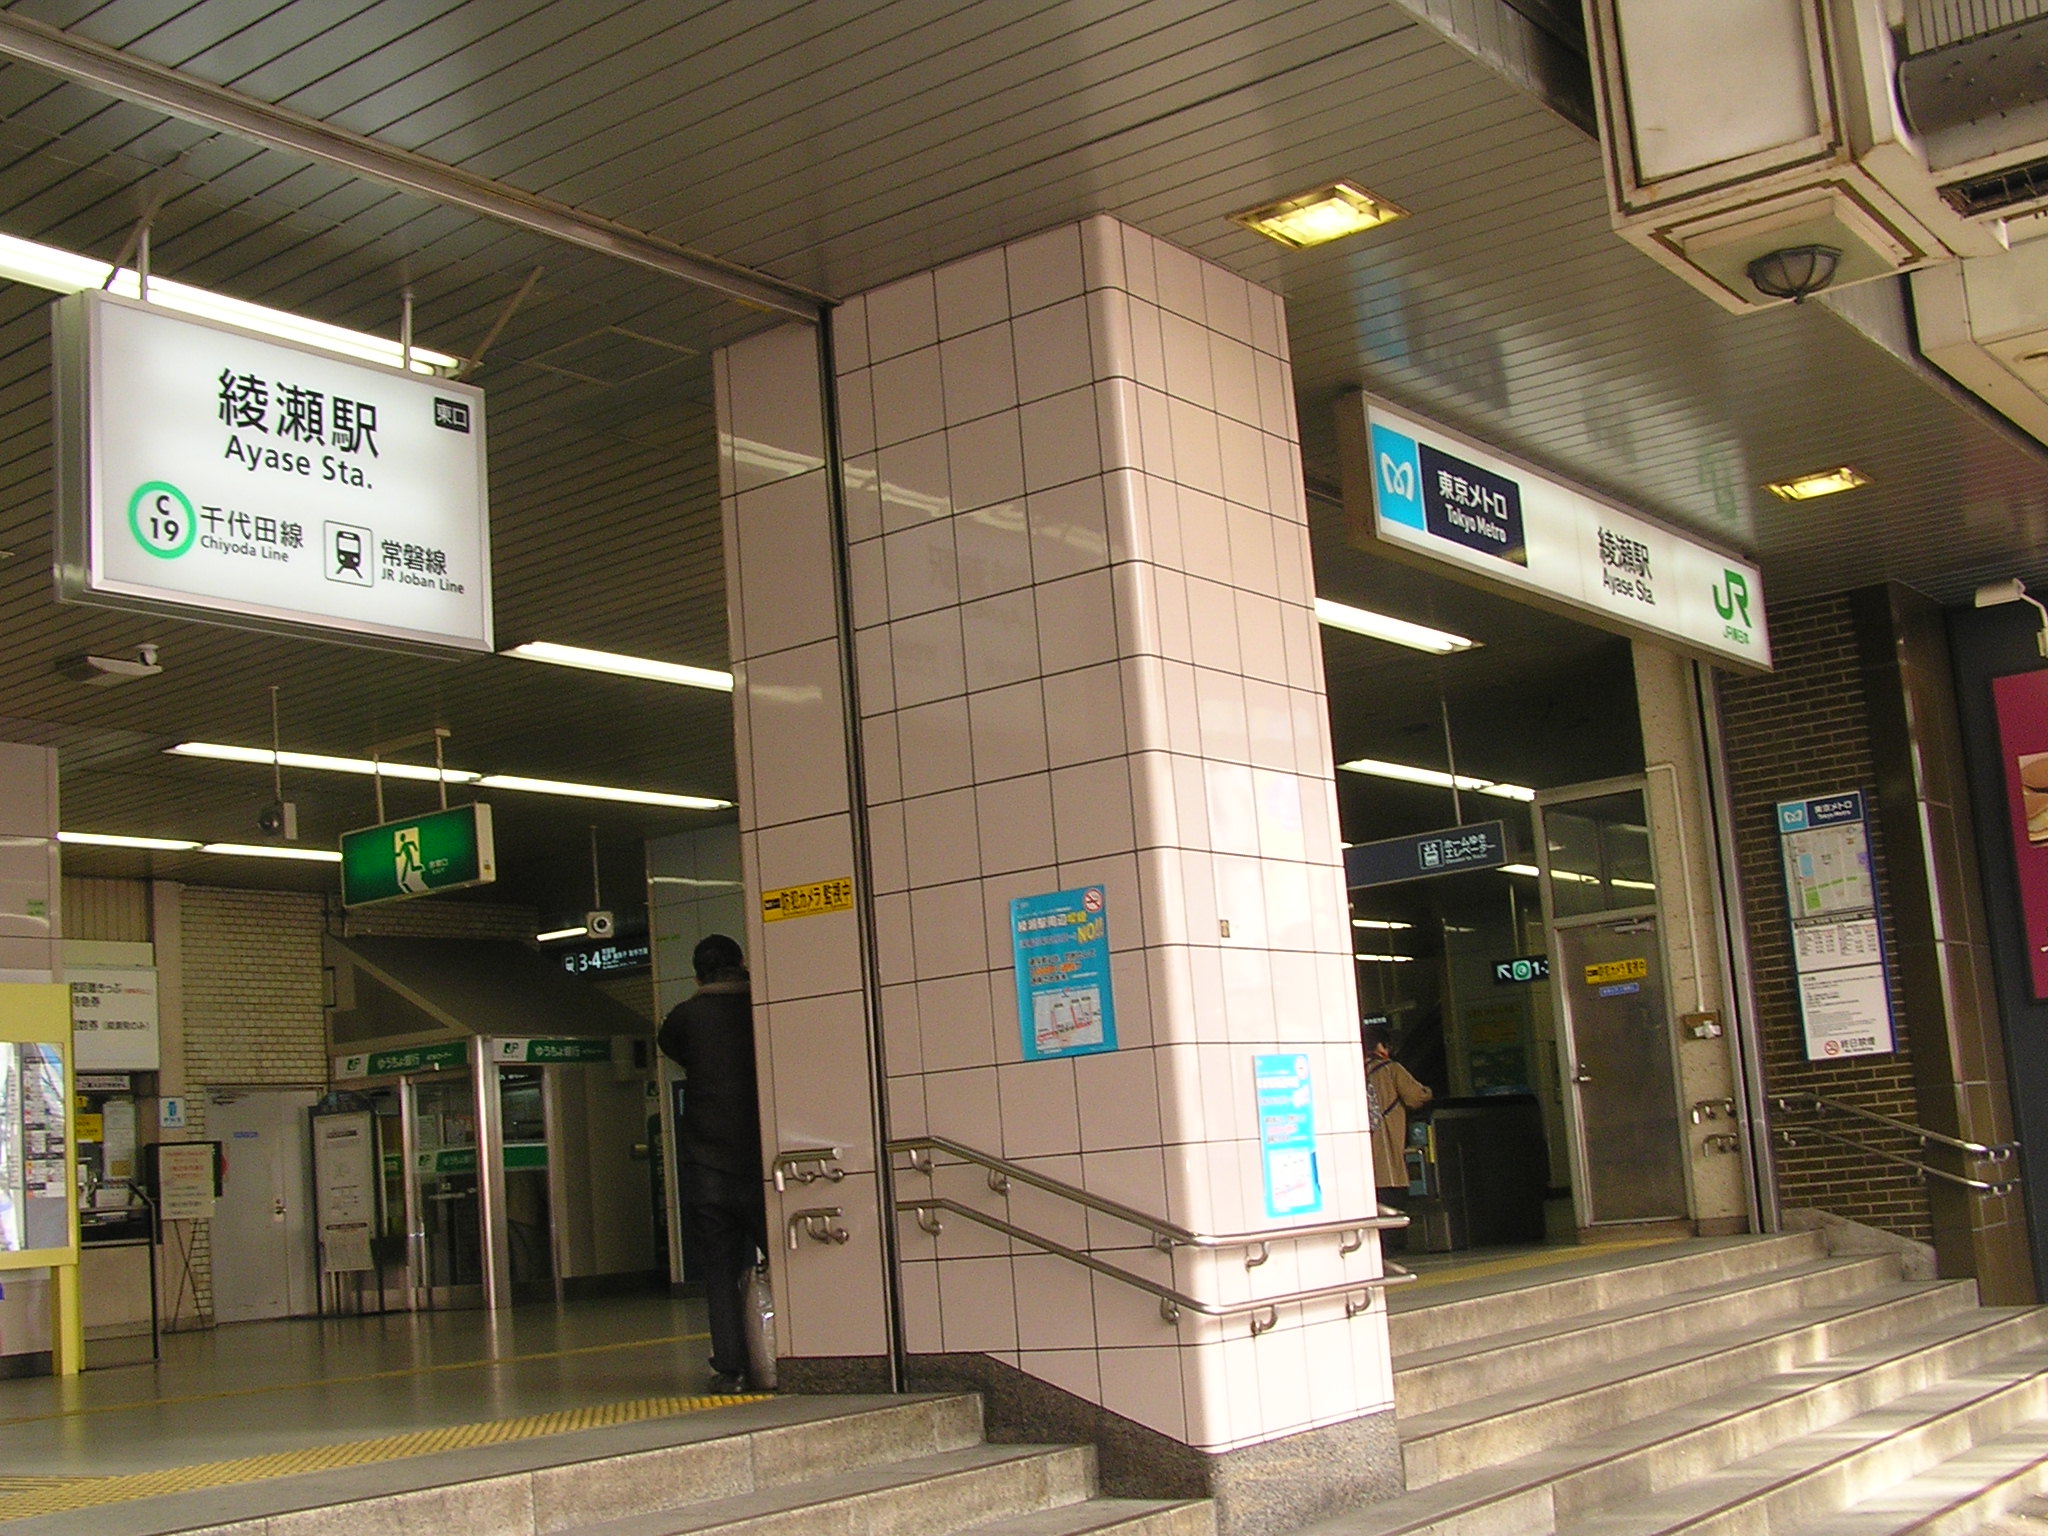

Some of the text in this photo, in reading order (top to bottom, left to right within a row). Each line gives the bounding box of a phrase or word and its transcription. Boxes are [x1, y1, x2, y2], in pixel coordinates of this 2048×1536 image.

[218, 367, 379, 458] 綾瀬駅
[436, 403, 467, 428] 東口
[224, 434, 374, 490] Ayase Sta.
[156, 494, 170, 516] C
[1437, 469, 1508, 520] 東京メトロ
[150, 517, 180, 542] 19
[200, 505, 304, 549] 千代田線
[1444, 502, 1507, 543] Tokyo Metro
[200, 534, 290, 563] Chiyoda Line
[381, 539, 448, 576] 常磐線
[1598, 526, 1653, 581] 綾瀬駅
[381, 567, 465, 595] JR Joban Line
[1603, 567, 1634, 597] Ayase
[1712, 567, 1752, 628] JR
[1814, 800, 1853, 815] 東京メトロ
[1445, 844, 1496, 859] エレベーター
